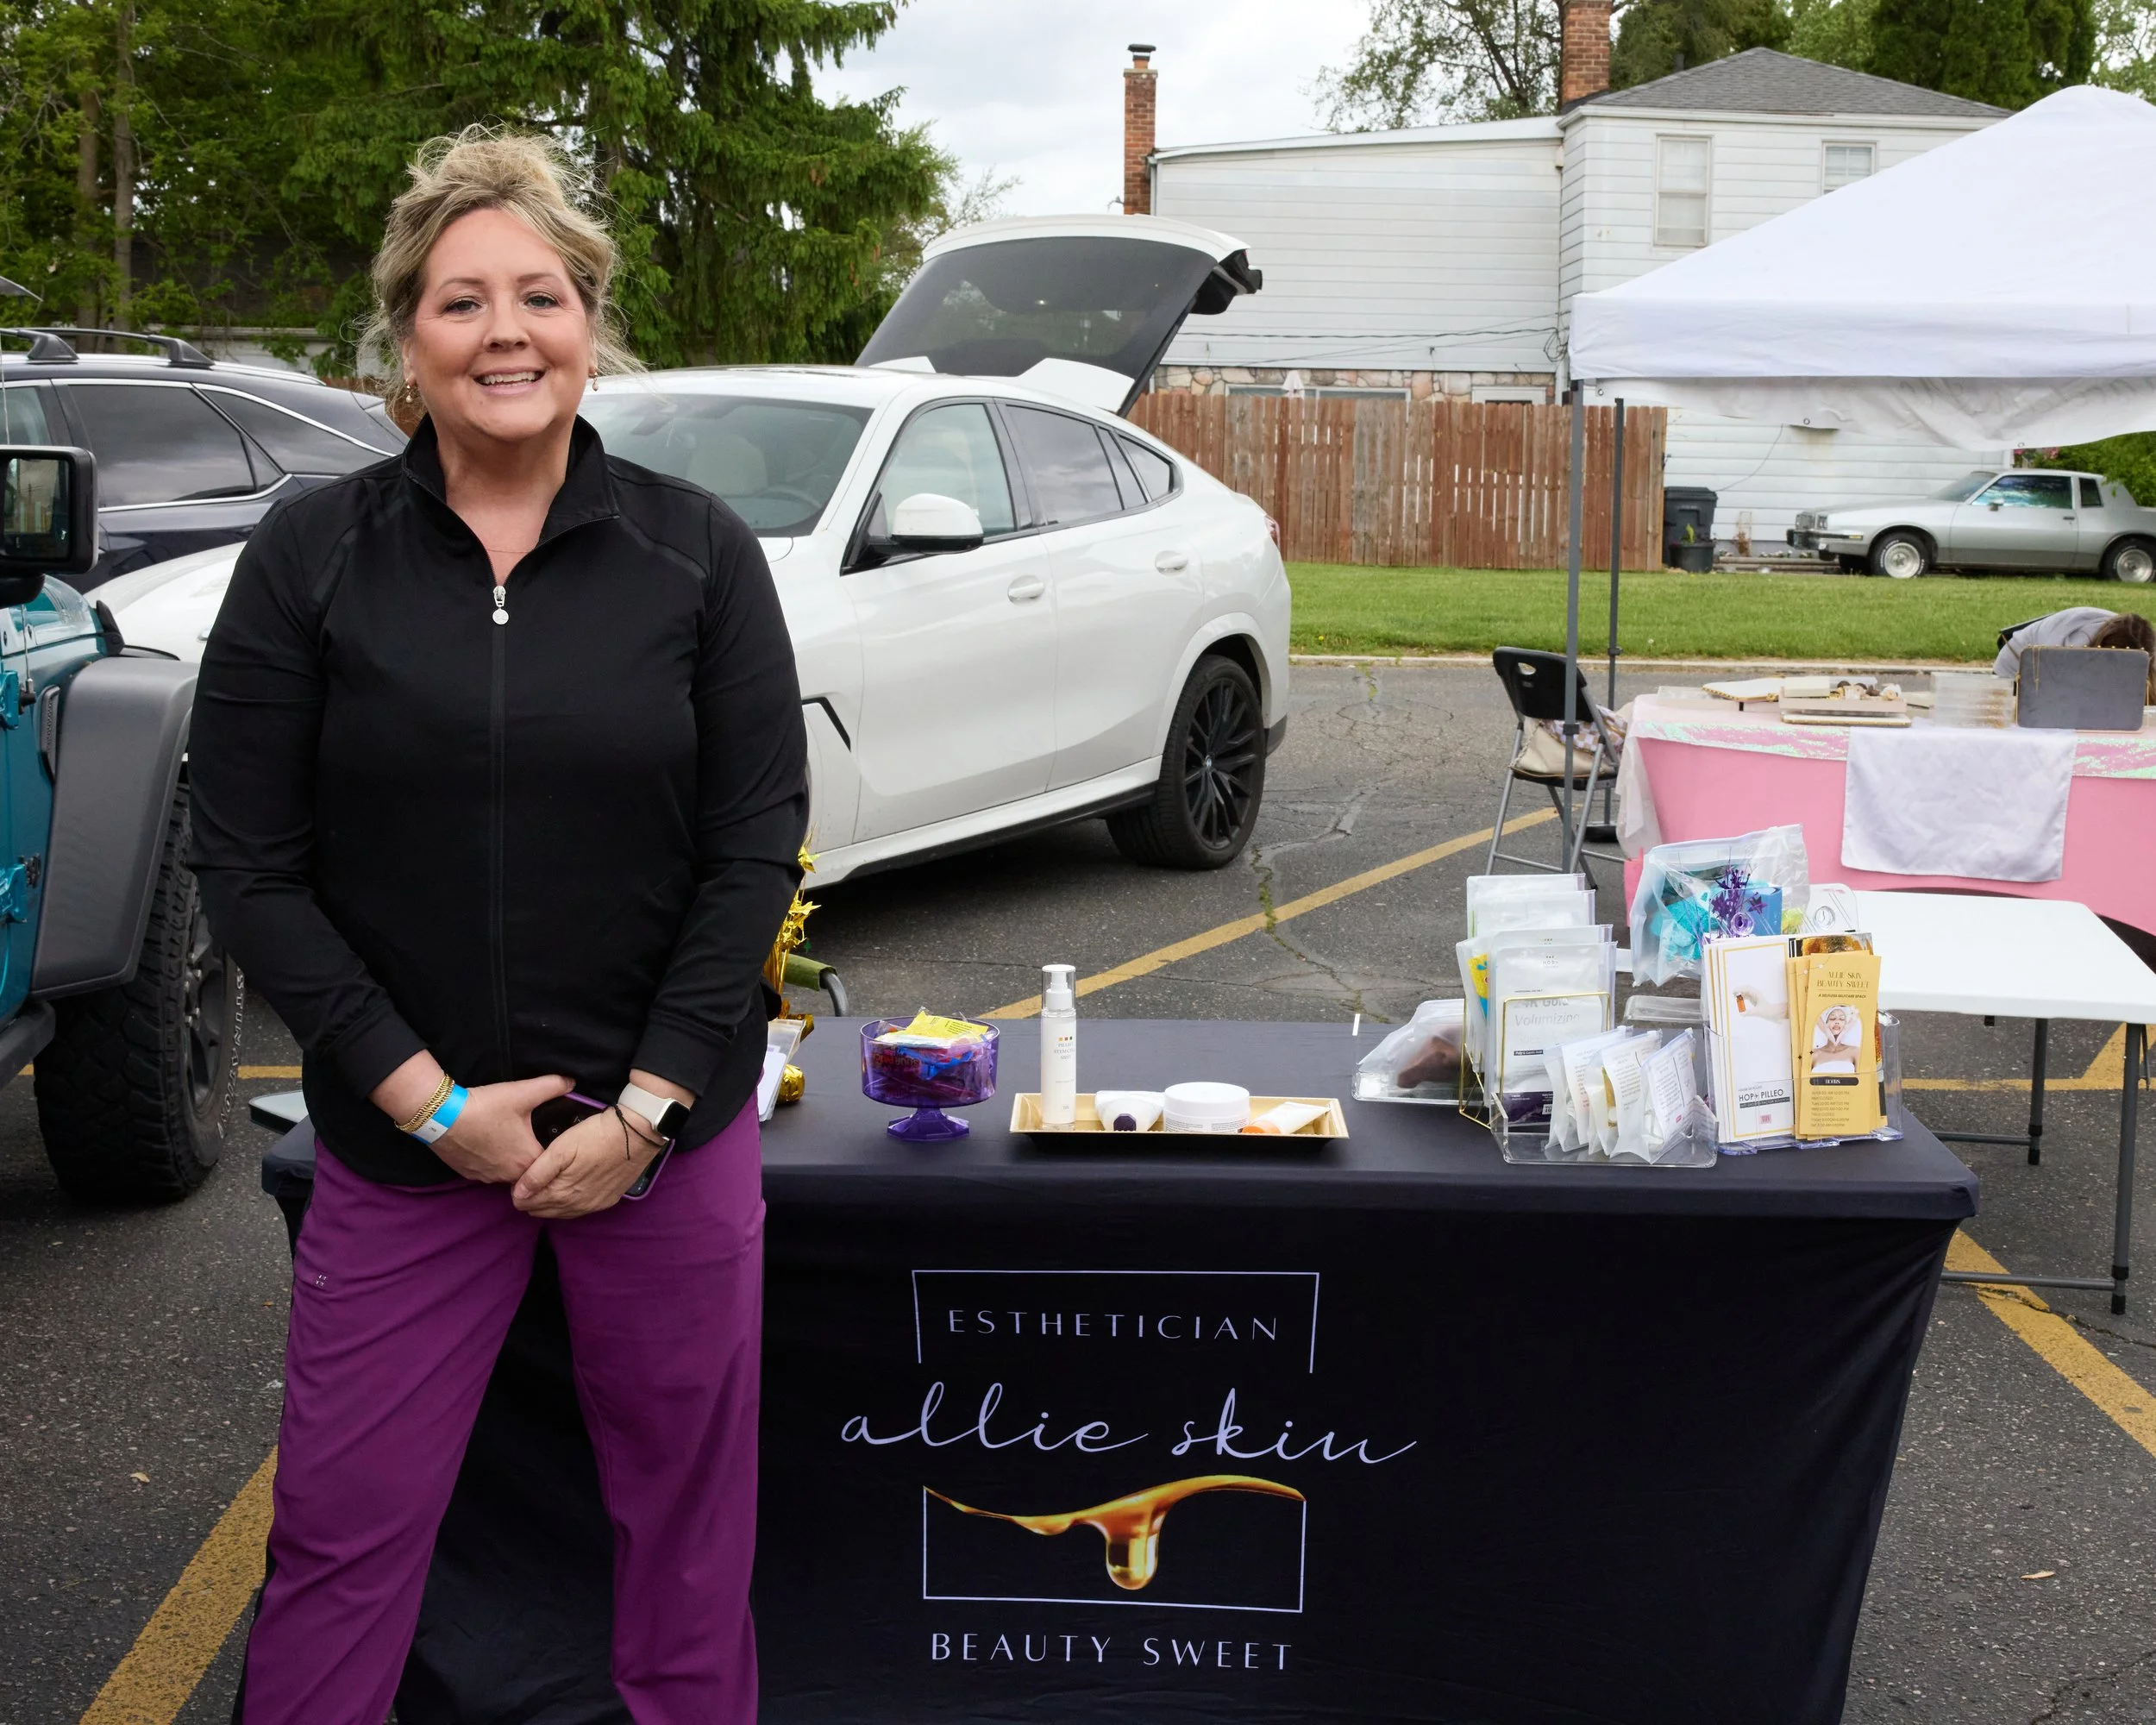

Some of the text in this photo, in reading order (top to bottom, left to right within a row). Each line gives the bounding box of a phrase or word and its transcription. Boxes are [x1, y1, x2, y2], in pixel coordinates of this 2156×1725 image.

[1816, 979, 1870, 988] BEAUTY SWEET
[217, 966, 244, 1139] STINATION
[1760, 1088, 1784, 1099] PILLEO
[949, 1309, 1278, 1342] ESTHETICIAN
[841, 1381, 1417, 1465] allie skin
[931, 1633, 1293, 1671] BEAUTY SWEET
